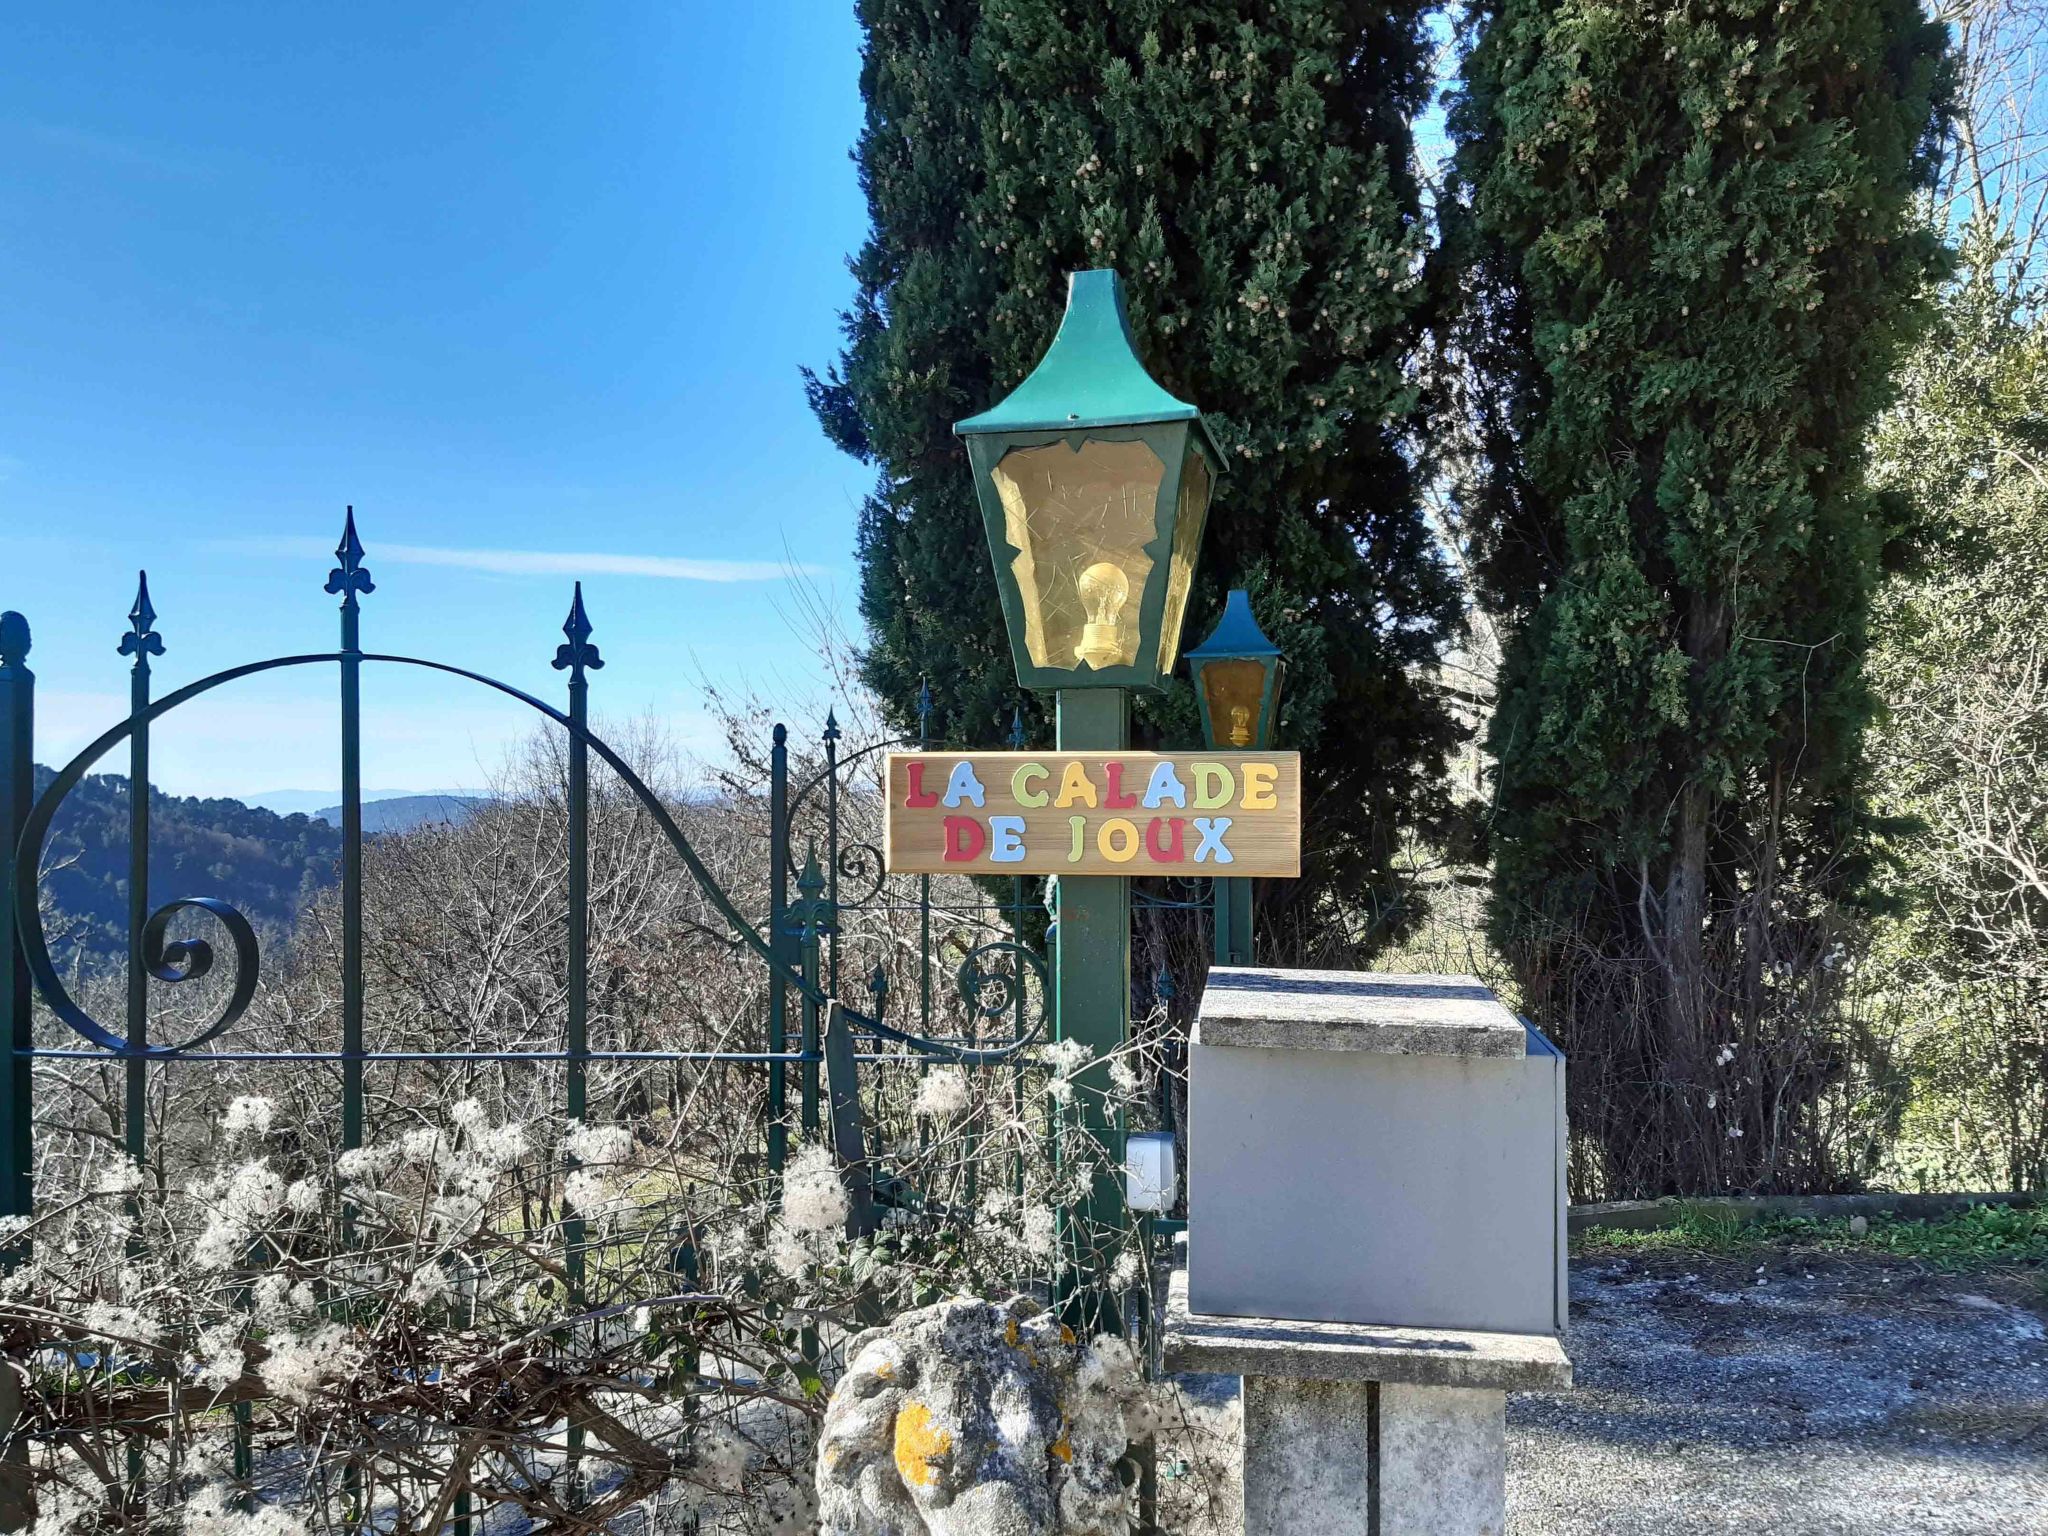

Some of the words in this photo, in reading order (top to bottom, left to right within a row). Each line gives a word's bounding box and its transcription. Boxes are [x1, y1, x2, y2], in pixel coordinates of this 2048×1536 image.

[904, 761, 986, 808] LA
[1010, 760, 1278, 809] CALADE
[943, 815, 1026, 862] DE
[1066, 815, 1234, 864] JOUX
